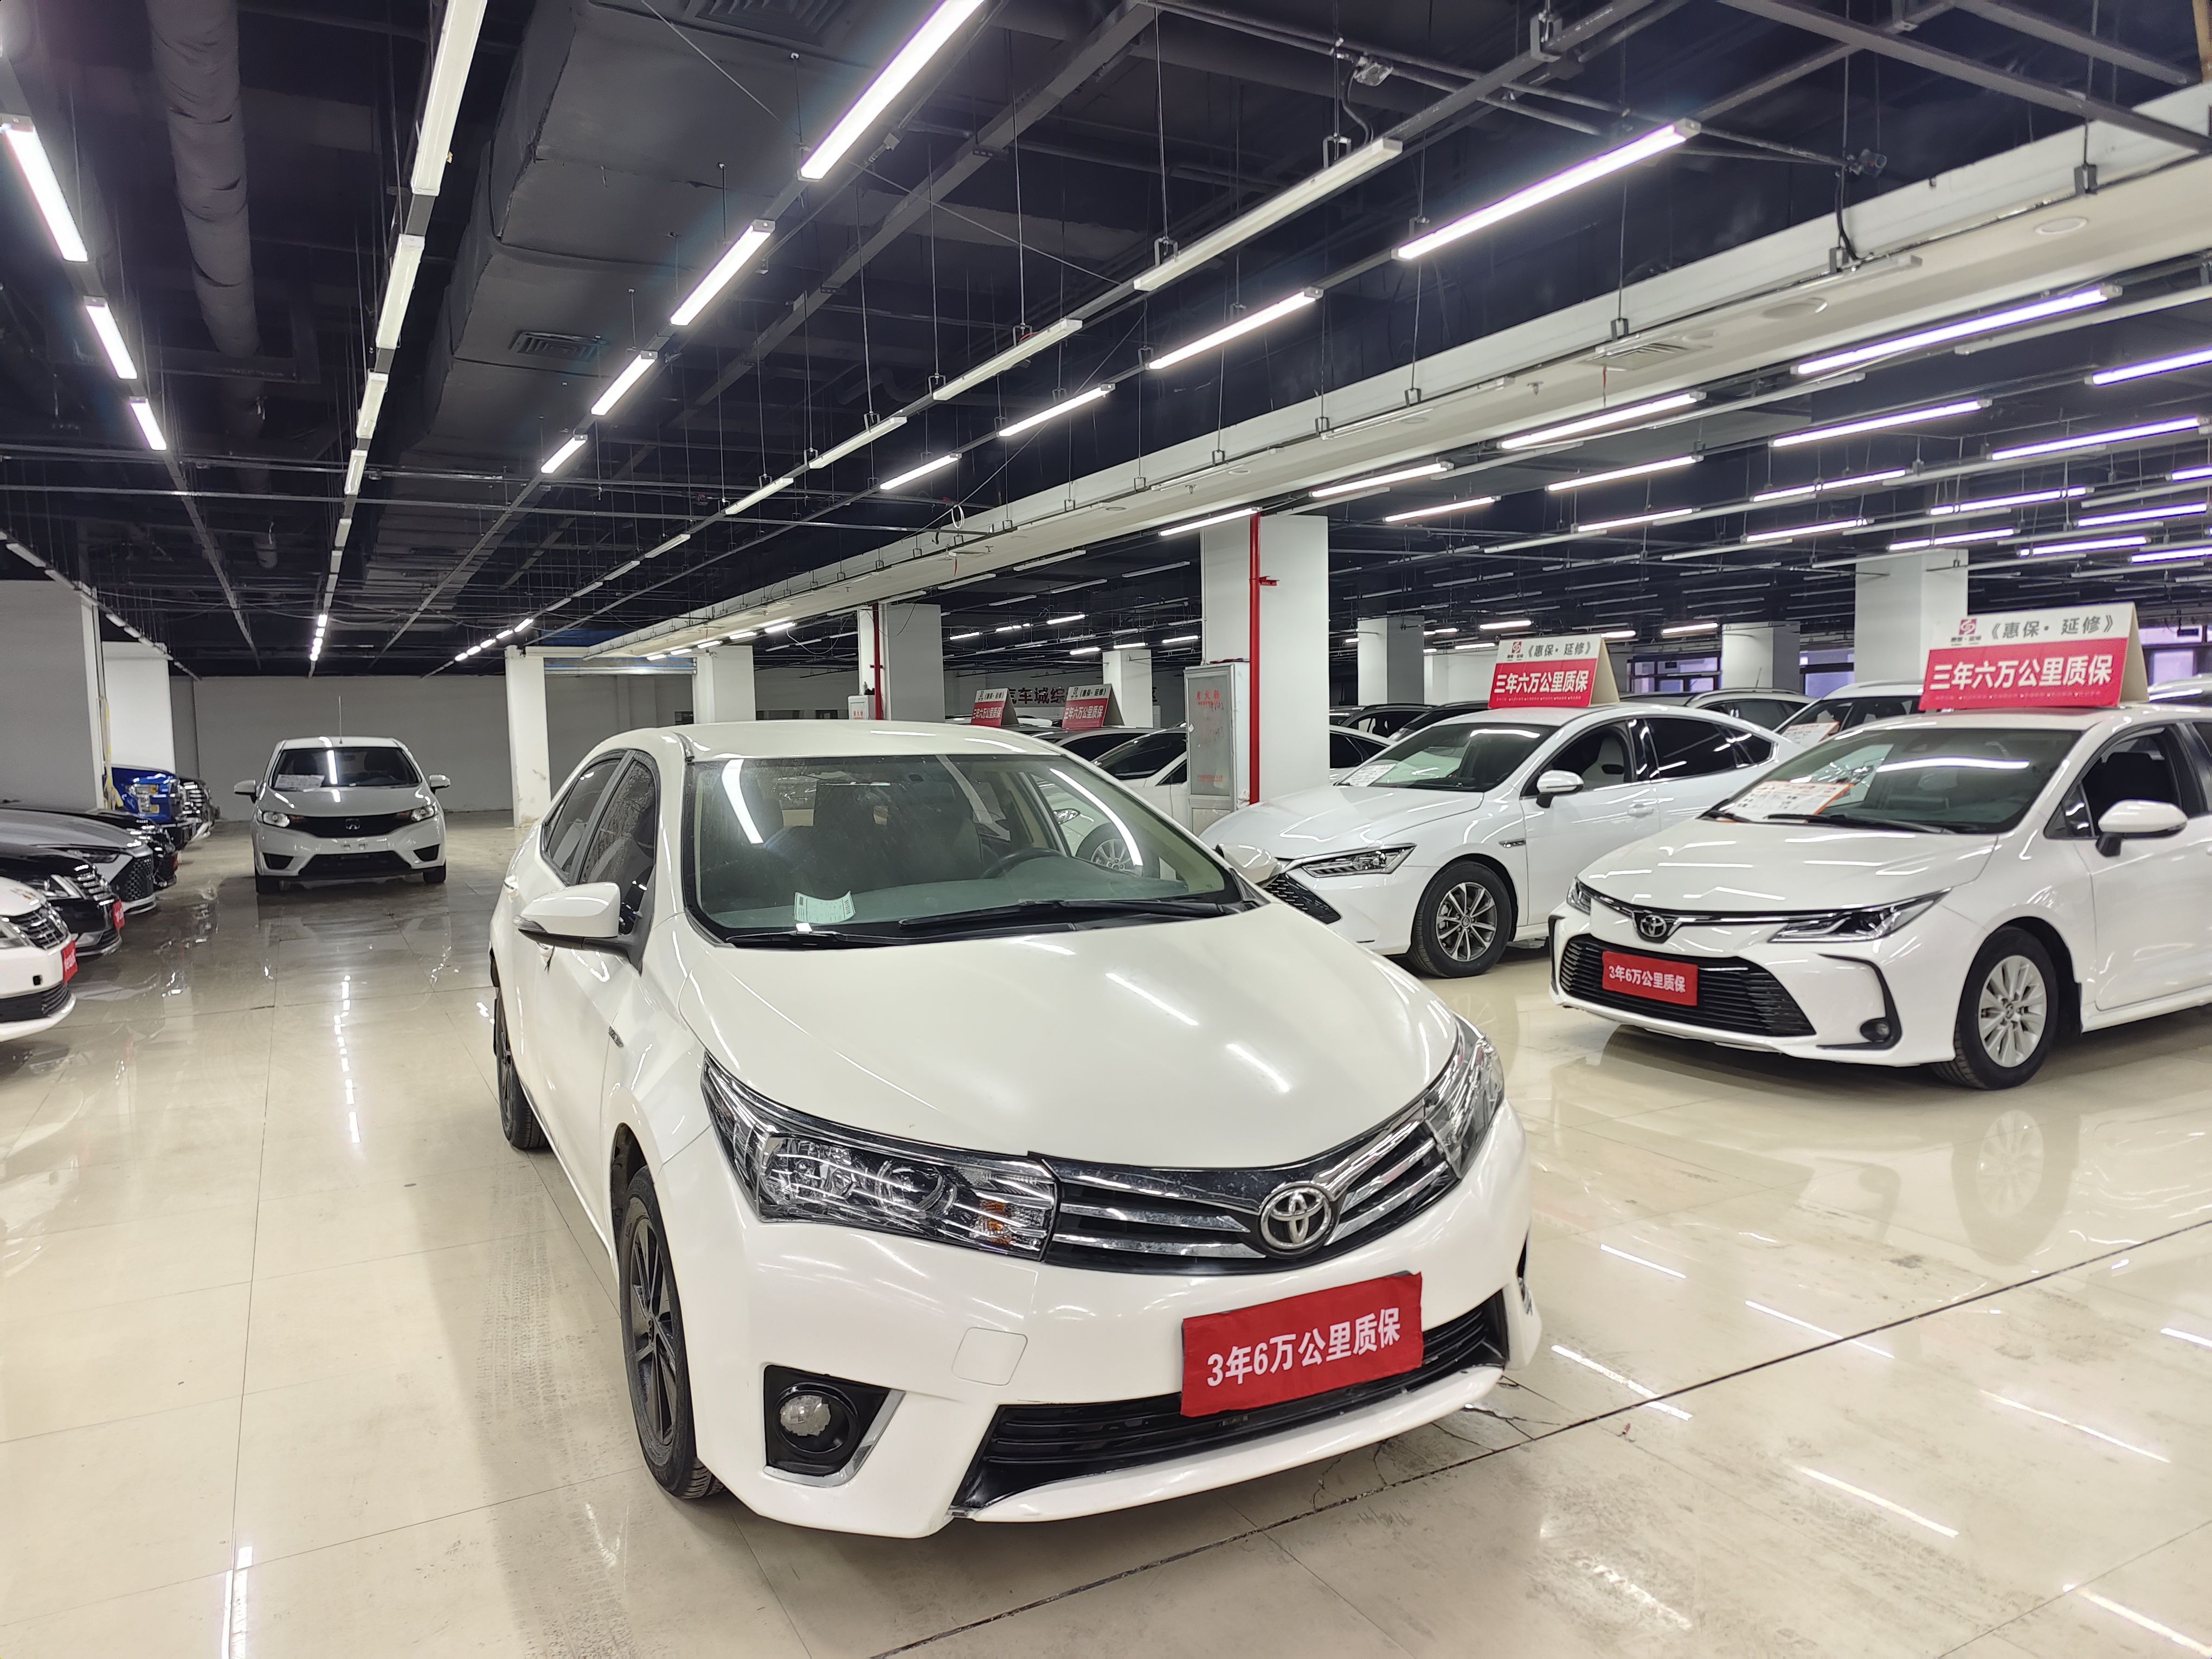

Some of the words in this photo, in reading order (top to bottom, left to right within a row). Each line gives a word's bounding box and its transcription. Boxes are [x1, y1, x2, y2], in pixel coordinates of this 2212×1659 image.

[1494, 670, 1590, 694] 三年六万公里质保
[1929, 654, 2113, 690] 三年六万公里质保
[1064, 705, 1104, 720] 三年六万公里质保
[1609, 965, 1686, 993] 3年6万公里质保
[1207, 1307, 1400, 1386] 3年6万公里质保
